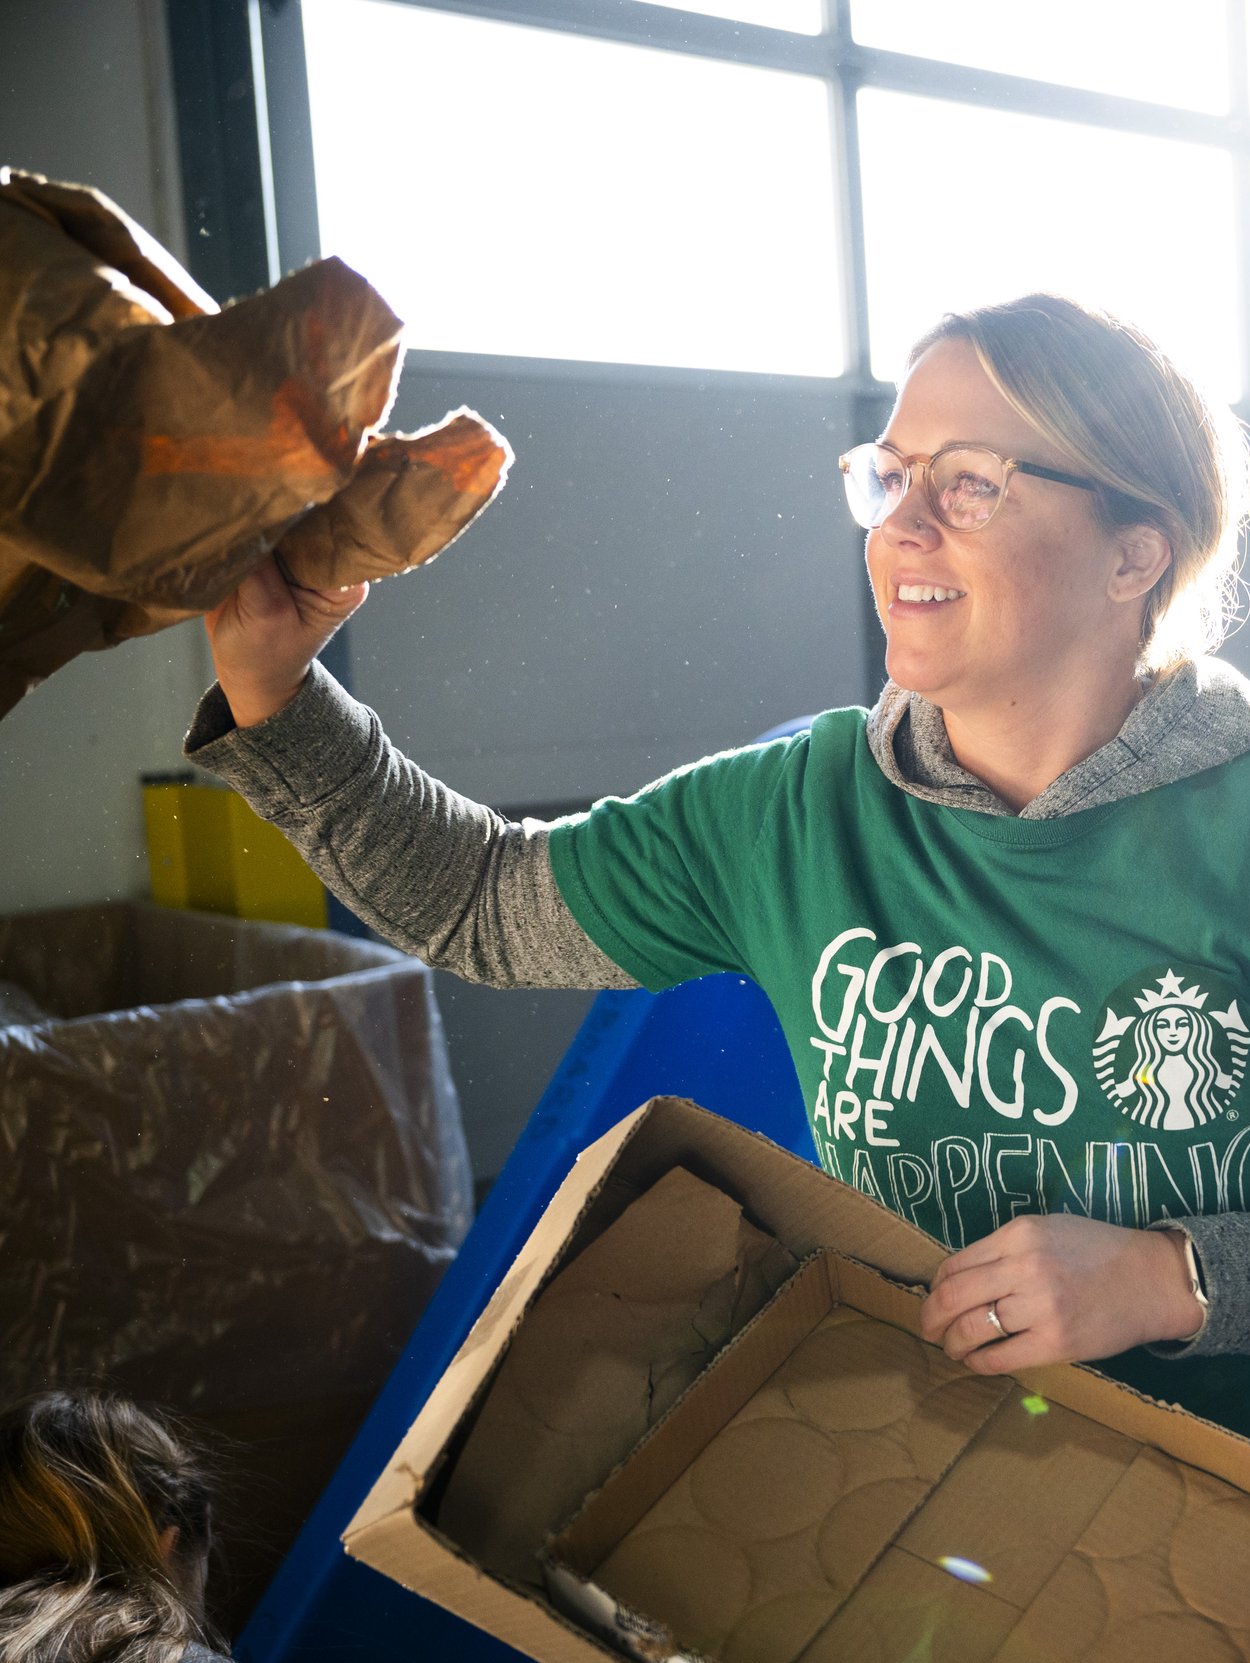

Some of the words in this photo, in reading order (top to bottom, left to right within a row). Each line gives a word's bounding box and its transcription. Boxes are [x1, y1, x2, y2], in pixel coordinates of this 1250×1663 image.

[811, 927, 1012, 1043] GOOD
[810, 996, 1081, 1126] THINGS
[813, 1081, 900, 1147] ARE
